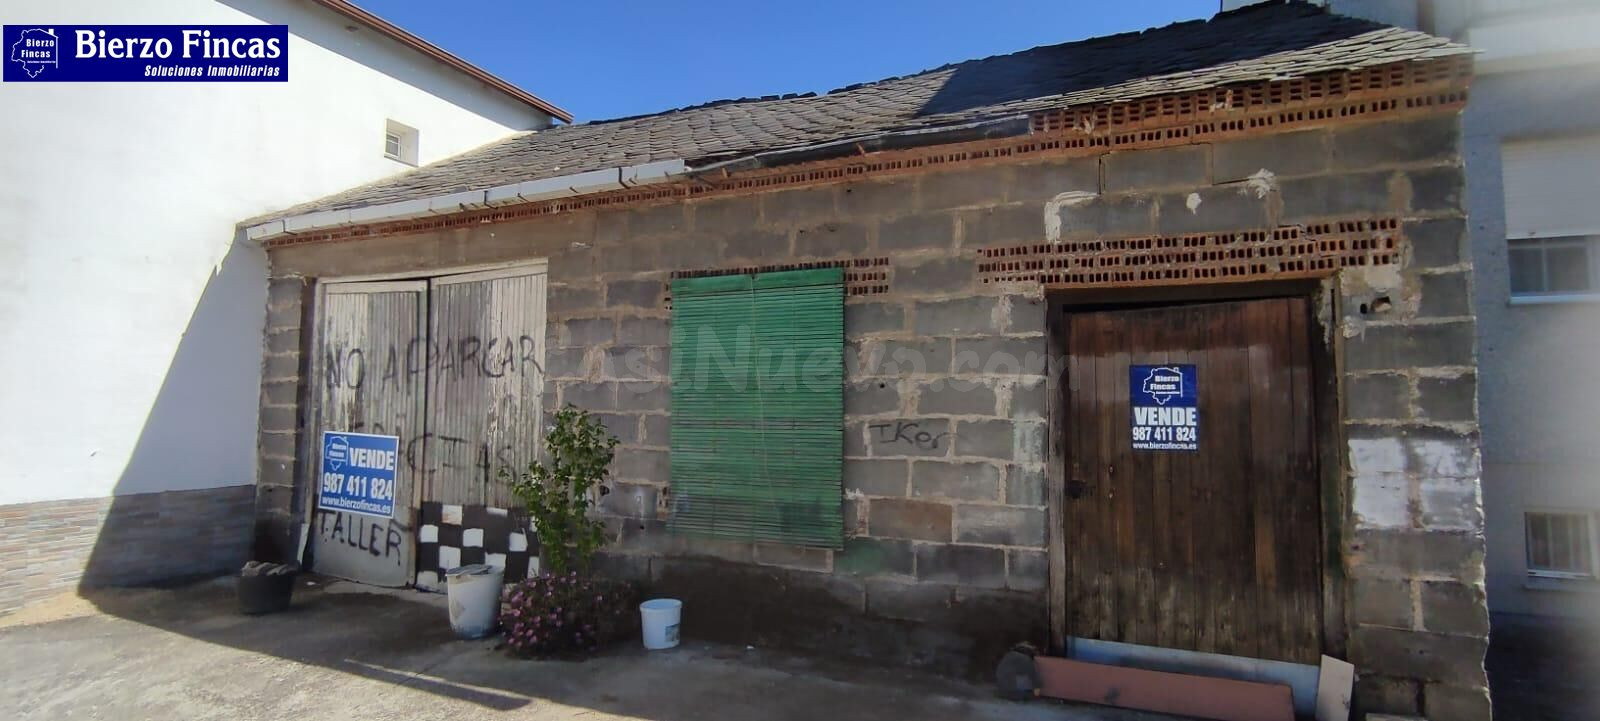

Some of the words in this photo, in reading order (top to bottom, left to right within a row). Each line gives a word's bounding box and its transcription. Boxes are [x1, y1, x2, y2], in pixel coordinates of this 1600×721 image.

[326, 343, 365, 390] NO
[1134, 407, 1197, 426] VENDE
[1132, 426, 1152, 441] 987
[1154, 426, 1173, 441] 411
[1175, 426, 1196, 441] 824
[1132, 441, 1197, 450] www.bierzofincas.es
[349, 447, 395, 471] VENDE
[323, 472, 345, 494] 987
[346, 475, 367, 498] 411
[370, 477, 393, 501] 824
[321, 496, 392, 514] www.bierzofincas.es
[317, 509, 403, 567] TALLER
